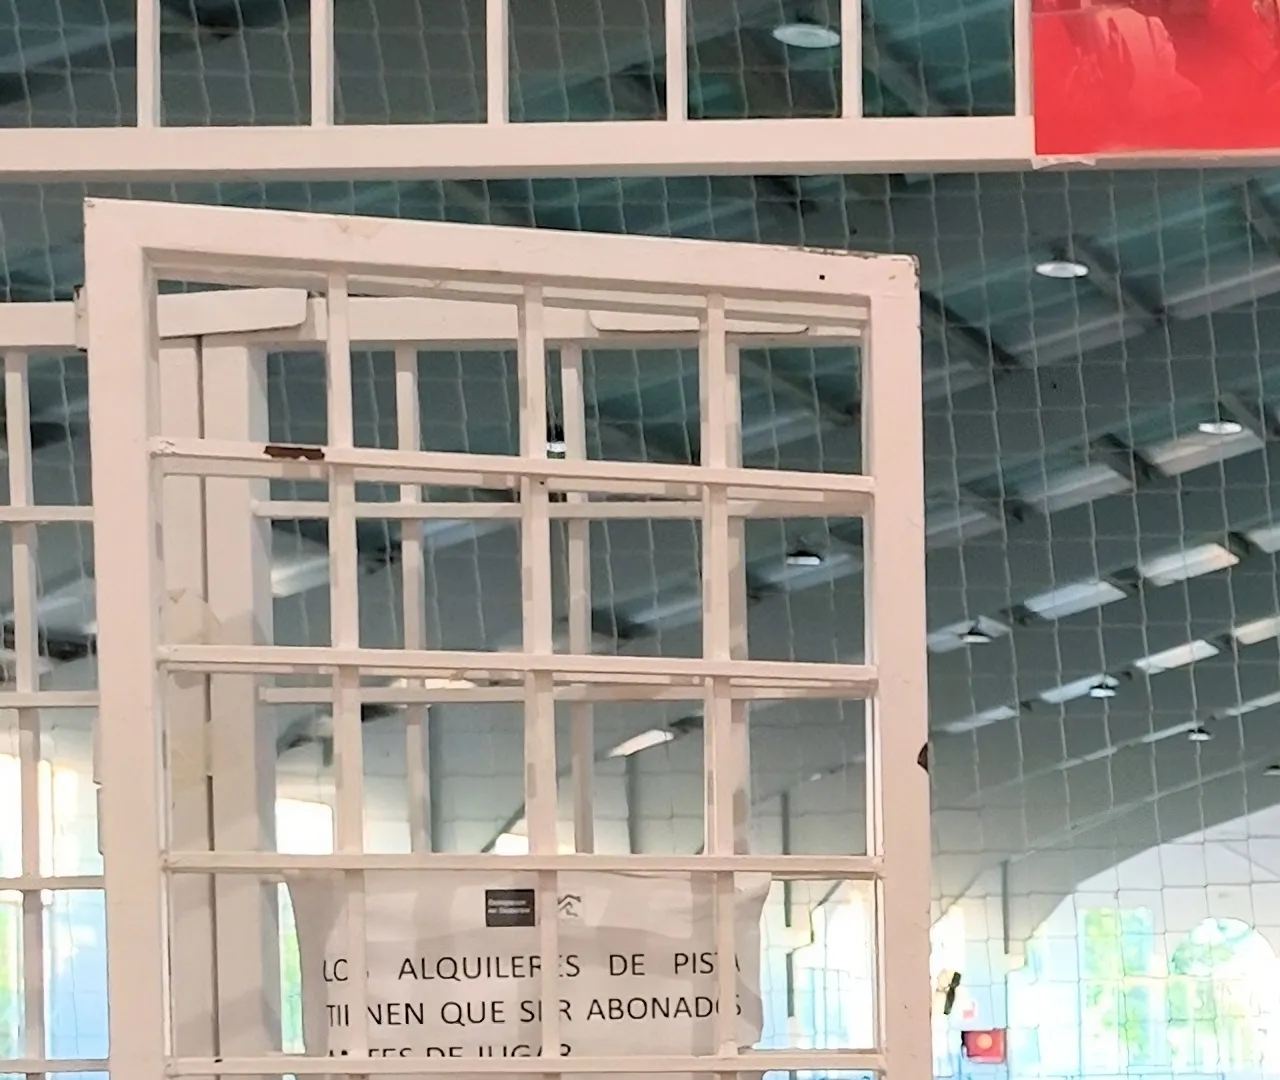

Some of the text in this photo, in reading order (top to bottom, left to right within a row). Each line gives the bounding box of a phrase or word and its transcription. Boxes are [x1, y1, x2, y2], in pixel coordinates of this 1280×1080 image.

[322, 958, 370, 982] LO
[609, 954, 646, 977] DE
[674, 952, 741, 975] PIS
[440, 1001, 506, 1026] QUE
